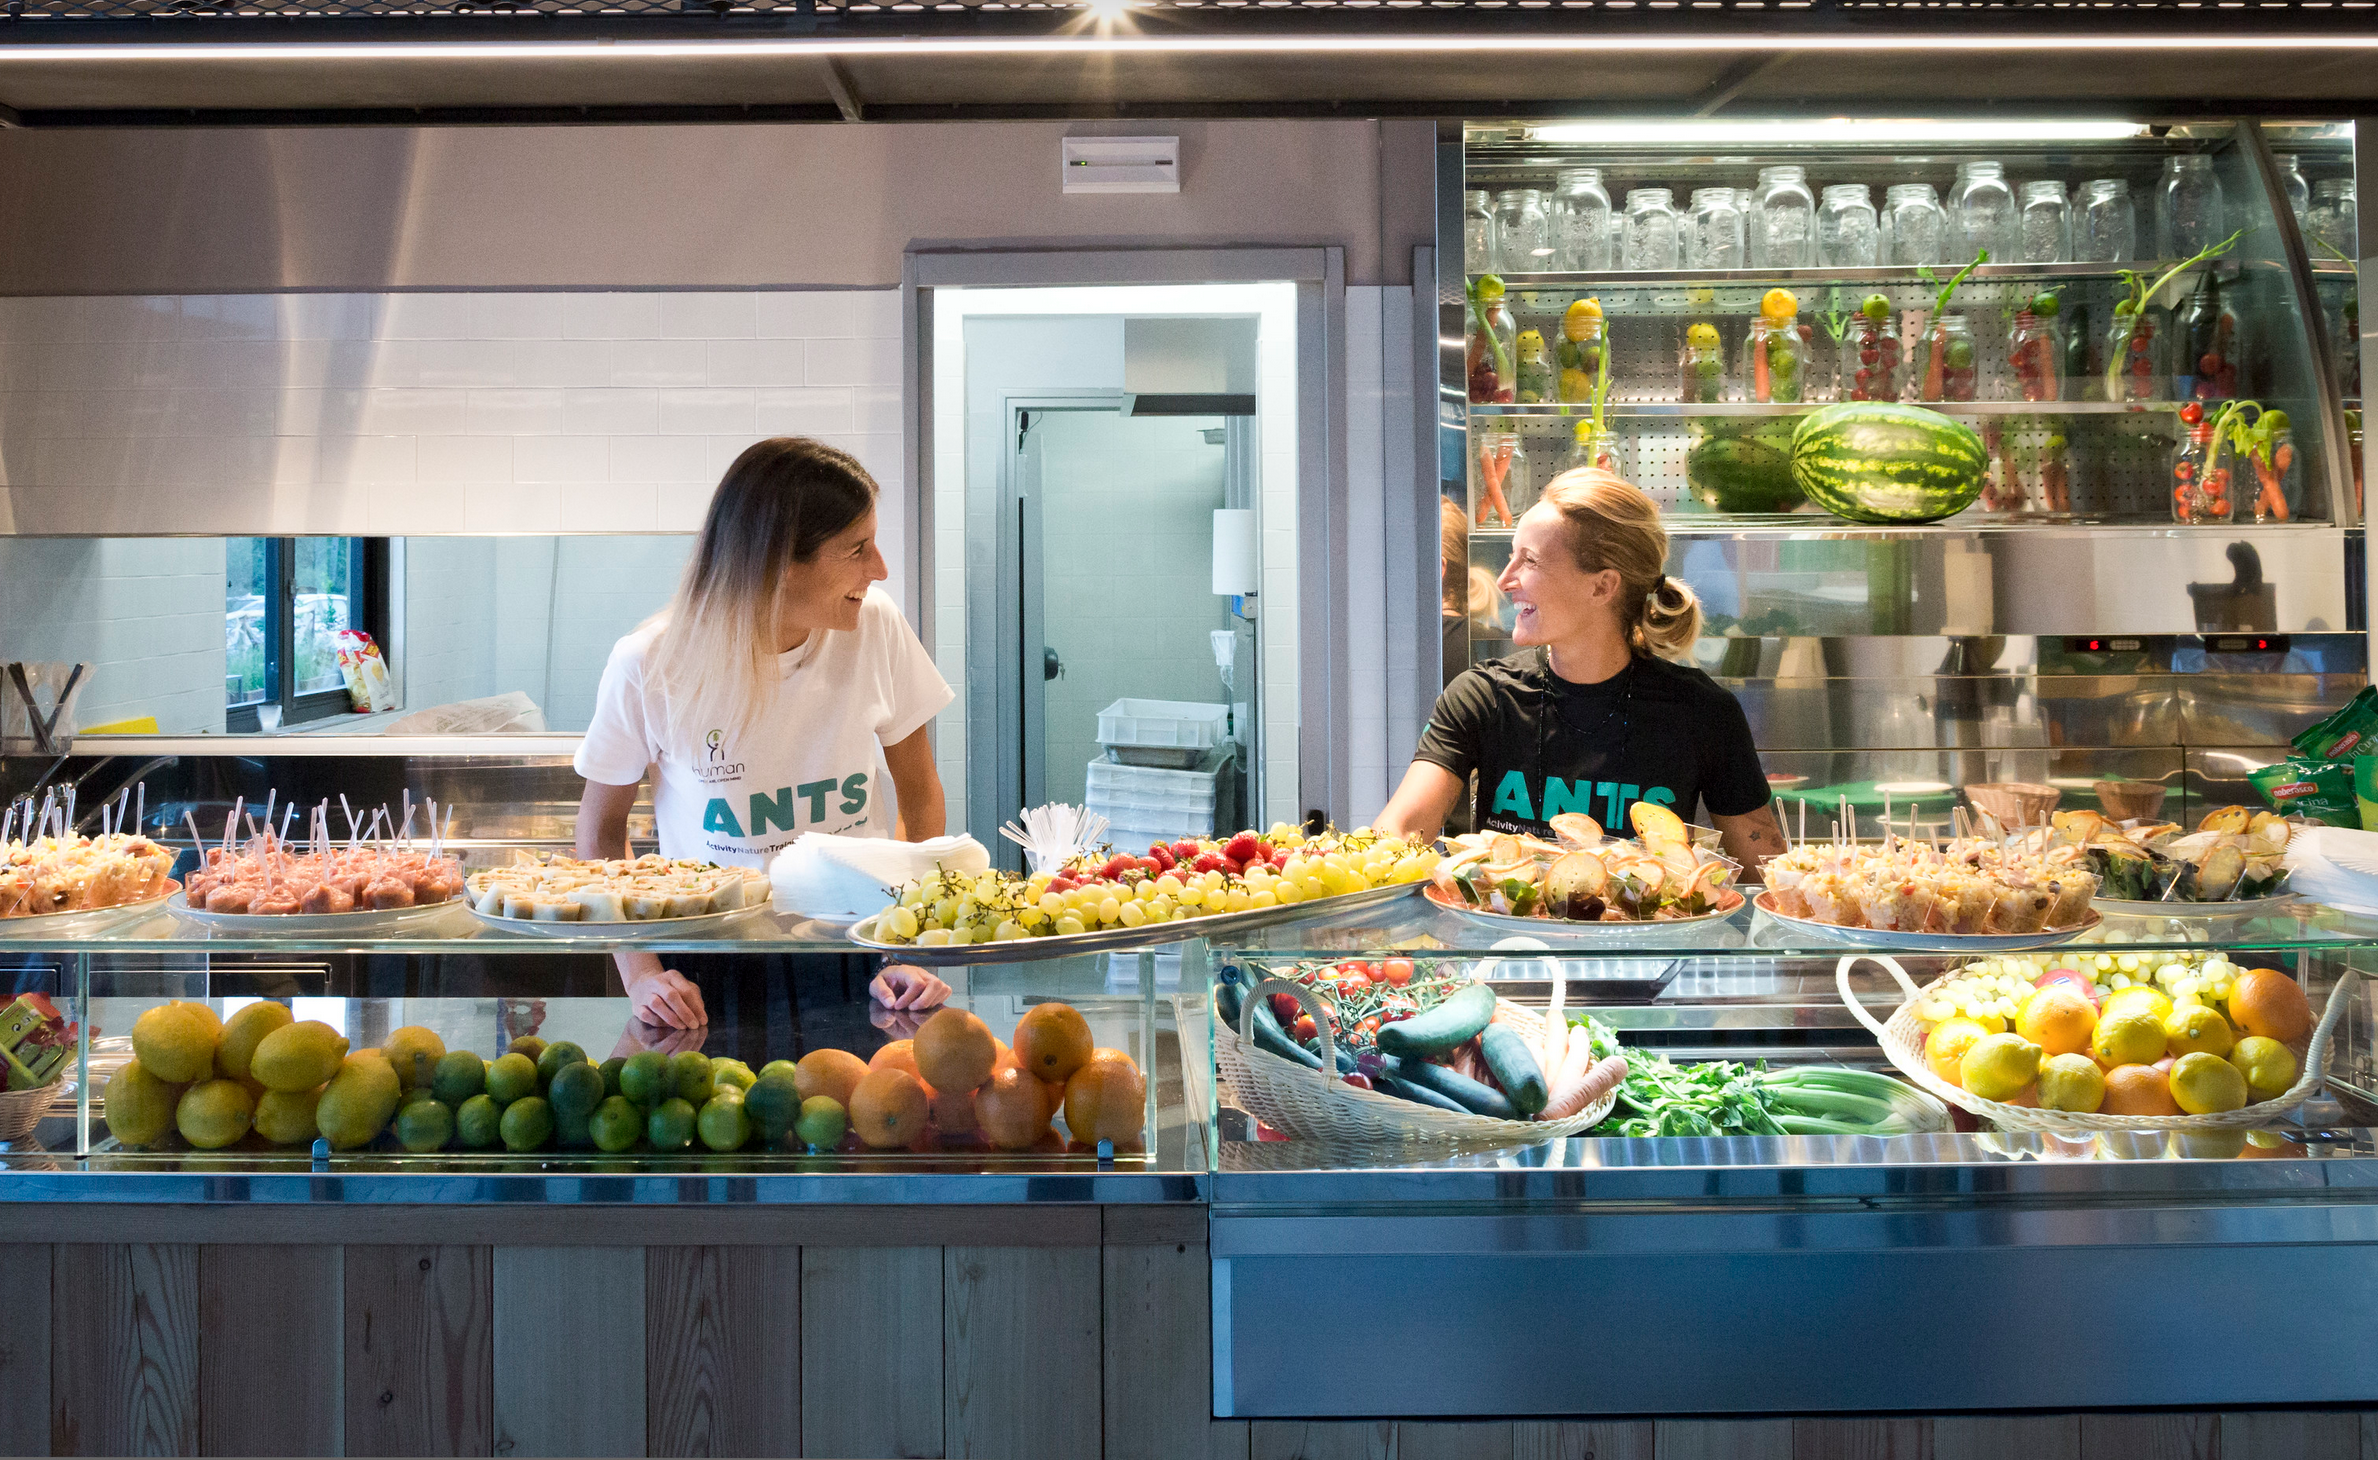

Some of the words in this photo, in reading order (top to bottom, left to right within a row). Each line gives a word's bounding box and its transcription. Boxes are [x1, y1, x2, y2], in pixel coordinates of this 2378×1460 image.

[2328, 734, 2358, 758] noberasco
[692, 763, 745, 777] human
[2274, 786, 2314, 797] noberasco
[703, 773, 868, 838] ANTS
